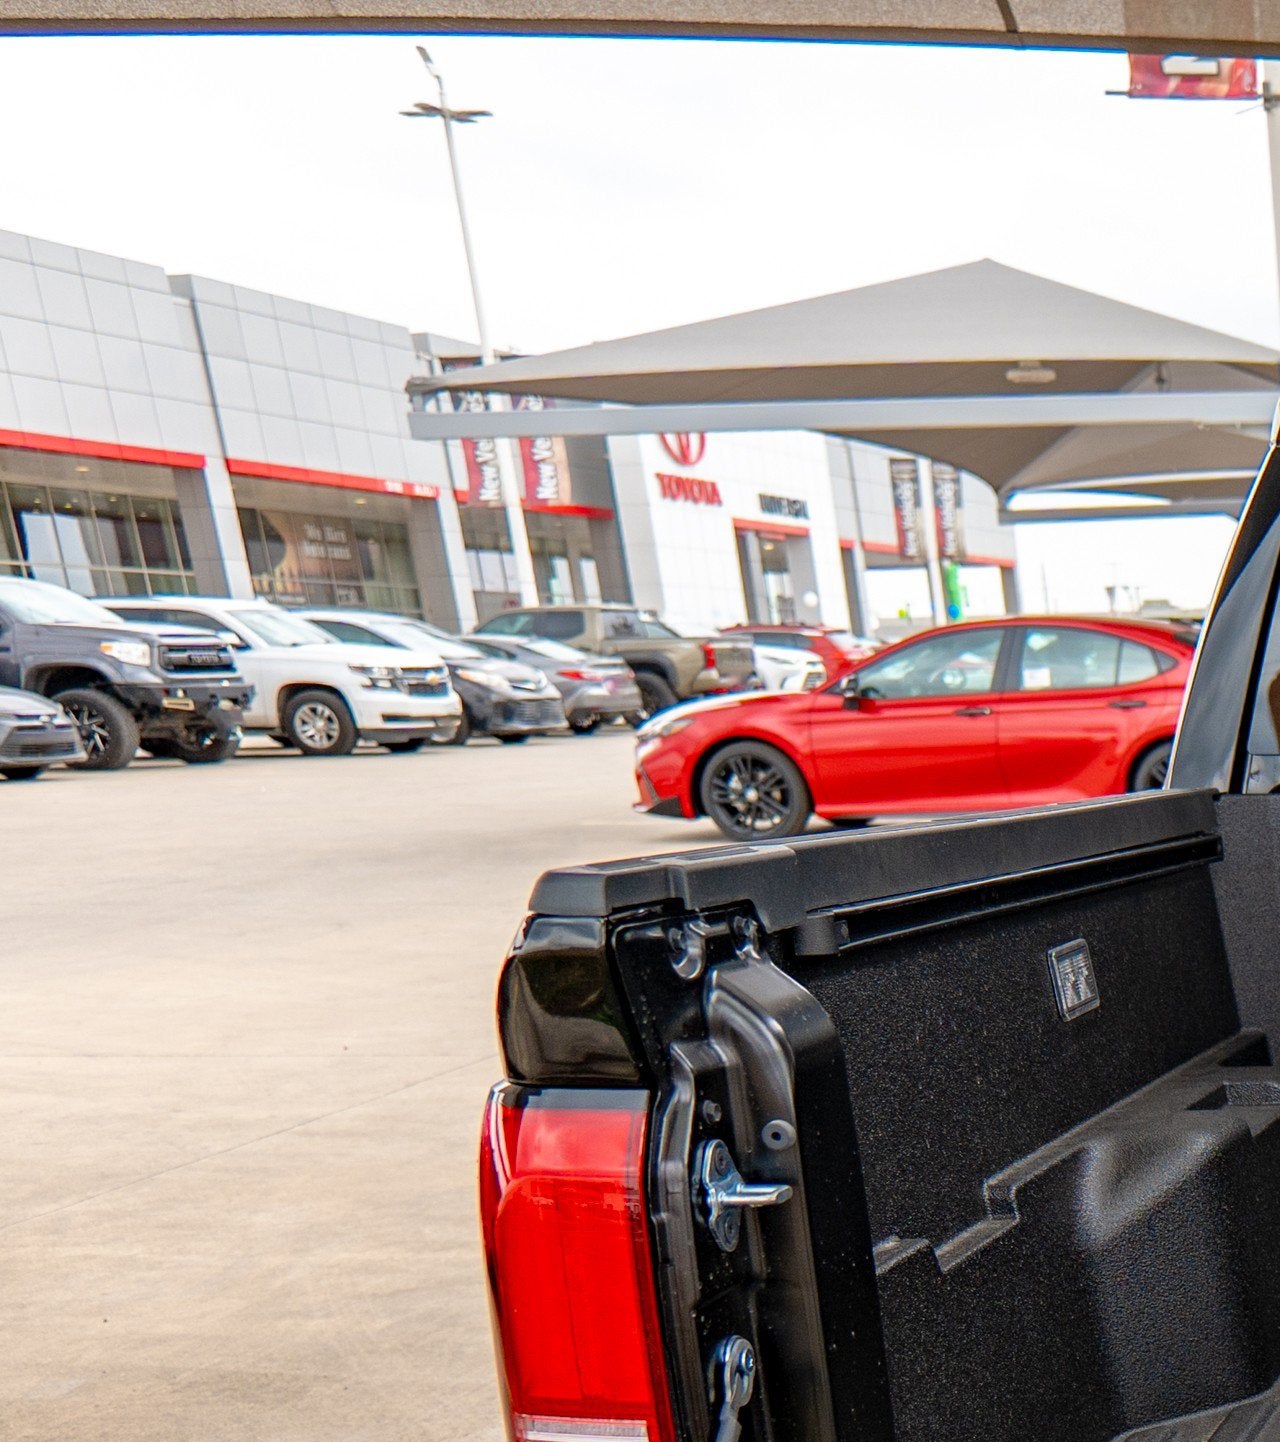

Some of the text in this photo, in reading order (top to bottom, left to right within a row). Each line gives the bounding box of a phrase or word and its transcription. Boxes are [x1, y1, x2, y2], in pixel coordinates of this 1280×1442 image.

[477, 463, 500, 501] New
[535, 461, 558, 499] New
[655, 473, 722, 506] TOYOTA
